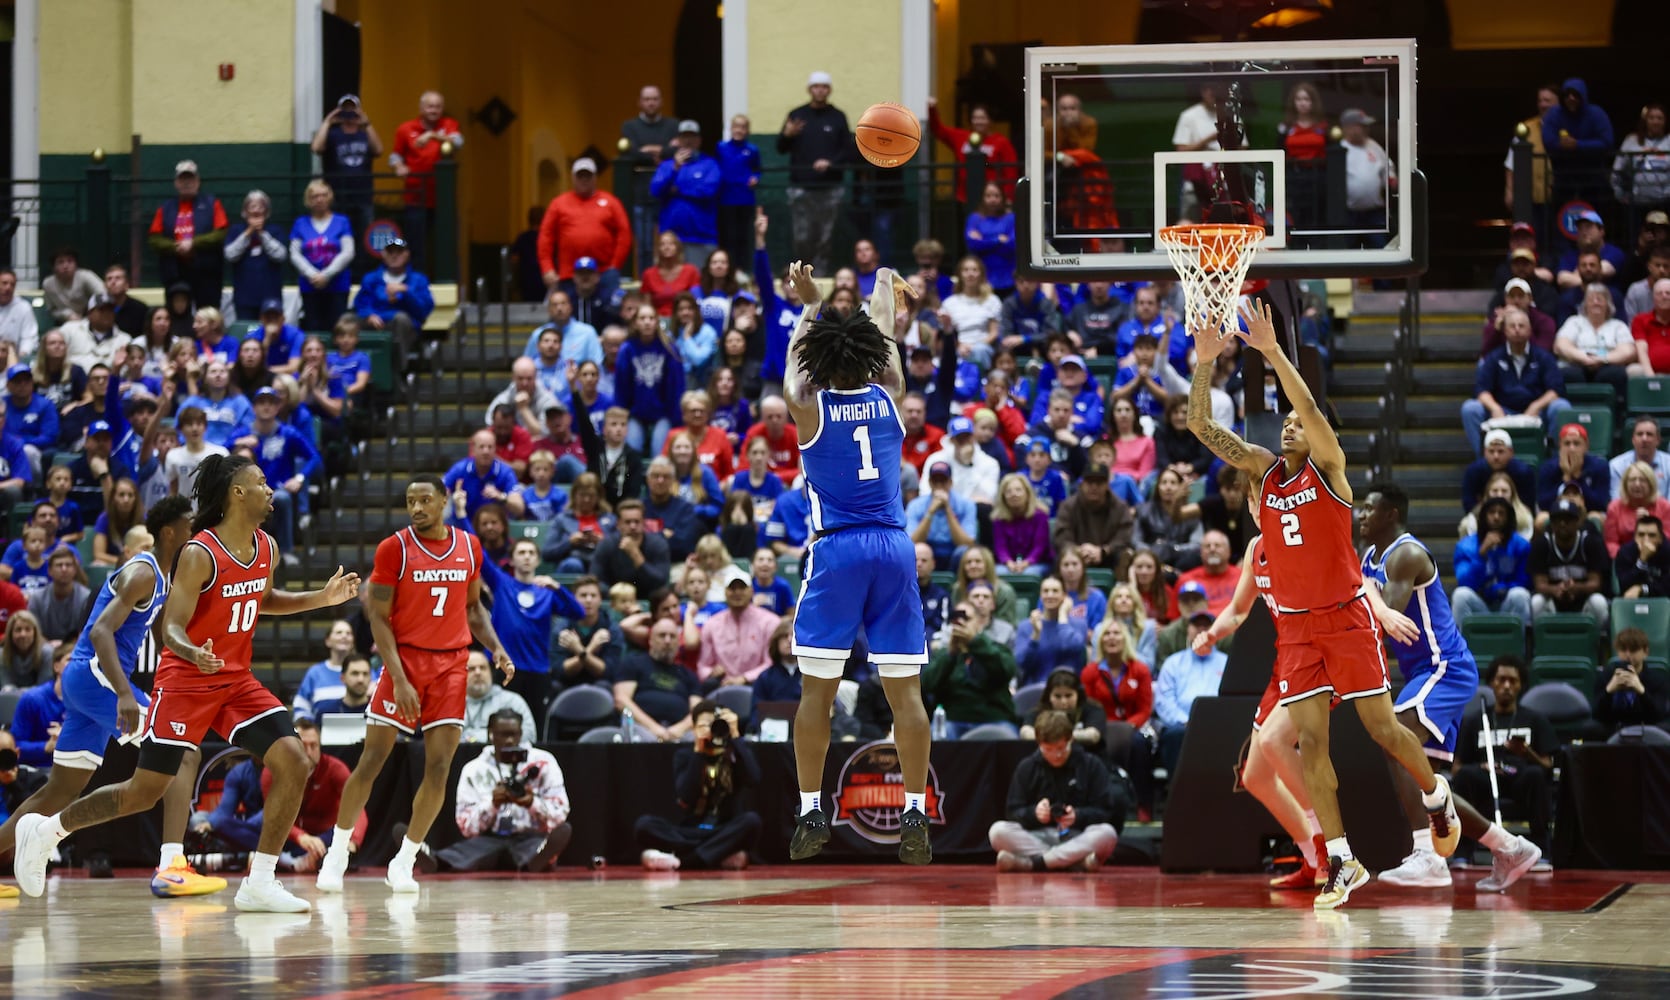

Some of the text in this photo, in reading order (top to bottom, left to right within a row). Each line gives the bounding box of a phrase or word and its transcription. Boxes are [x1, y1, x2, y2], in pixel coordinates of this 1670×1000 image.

[1043, 257, 1080, 265] SPALDING
[829, 399, 890, 421] WRIGHT III
[853, 426, 880, 480] 1
[1201, 426, 1244, 461] SACRIFICE
[1266, 487, 1317, 511] DATON
[1280, 513, 1304, 546] 2
[222, 578, 268, 598] DAYTON
[413, 570, 468, 582] DAYTON
[431, 586, 449, 617] 7
[228, 598, 258, 633] 10
